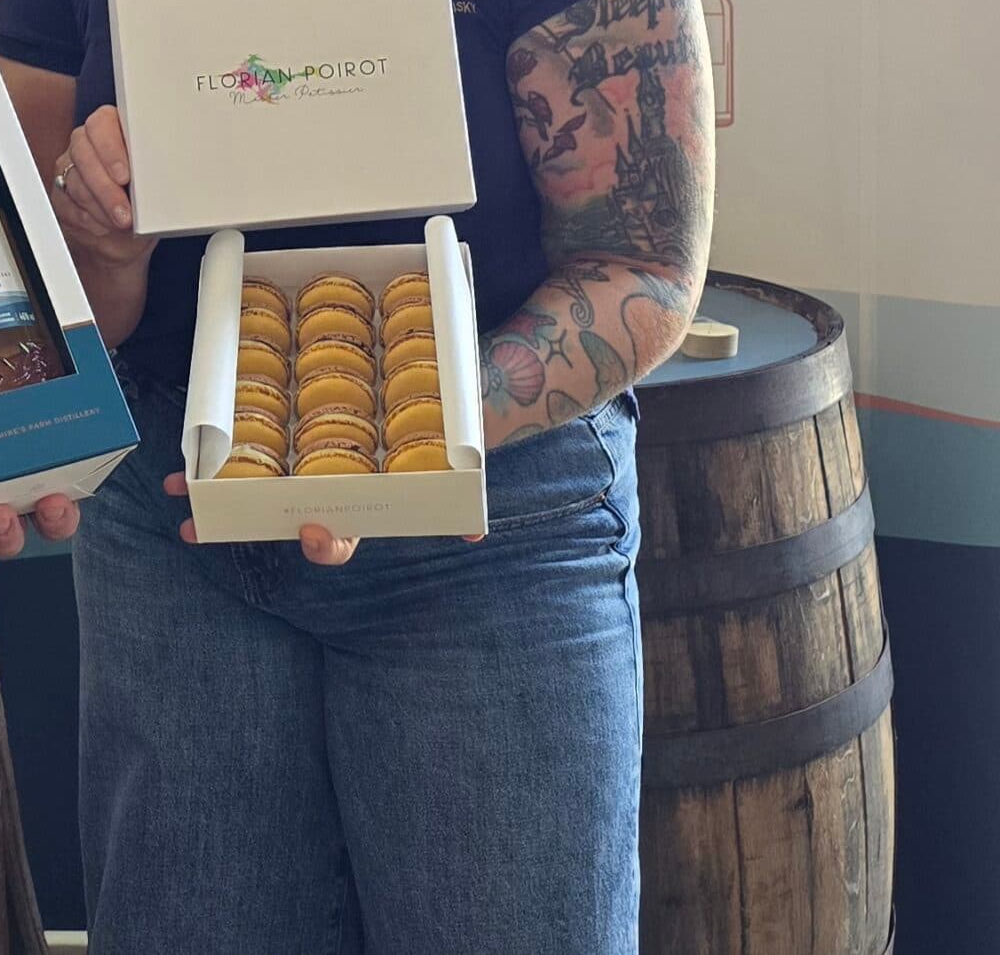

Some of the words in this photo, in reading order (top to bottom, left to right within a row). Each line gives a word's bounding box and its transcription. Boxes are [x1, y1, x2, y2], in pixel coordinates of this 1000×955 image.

[196, 66, 293, 92] FLORIAN
[304, 58, 388, 82] POIROT
[53, 407, 101, 425] DISTILLERY
